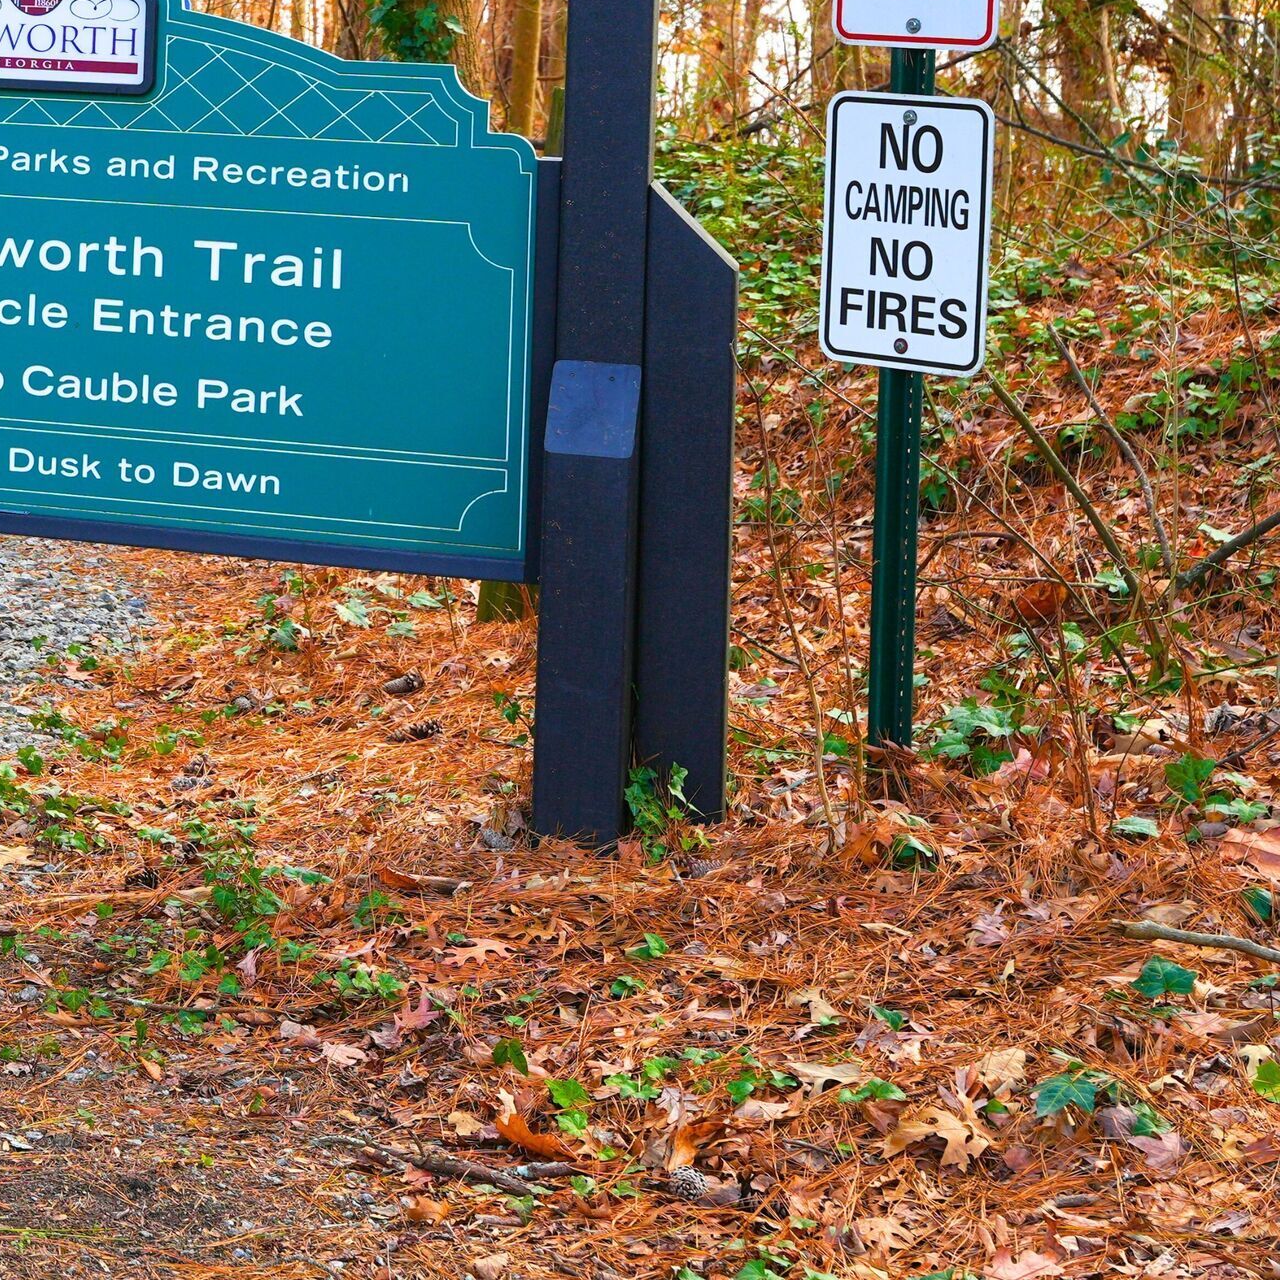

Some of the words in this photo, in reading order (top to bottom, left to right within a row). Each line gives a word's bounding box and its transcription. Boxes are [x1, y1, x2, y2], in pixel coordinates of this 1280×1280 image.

[880, 123, 943, 173] NO
[107, 156, 174, 179] and
[194, 157, 408, 192] Recreation
[846, 181, 969, 230] CAMPING
[194, 241, 341, 289] Trail
[870, 237, 932, 281] NO
[94, 299, 331, 347] Entrance
[840, 287, 967, 339] FIRES
[23, 366, 177, 406] Cauble
[198, 379, 303, 416] Park
[10, 448, 100, 478] Dusk
[119, 459, 155, 483] to
[174, 462, 279, 494] Dawn
